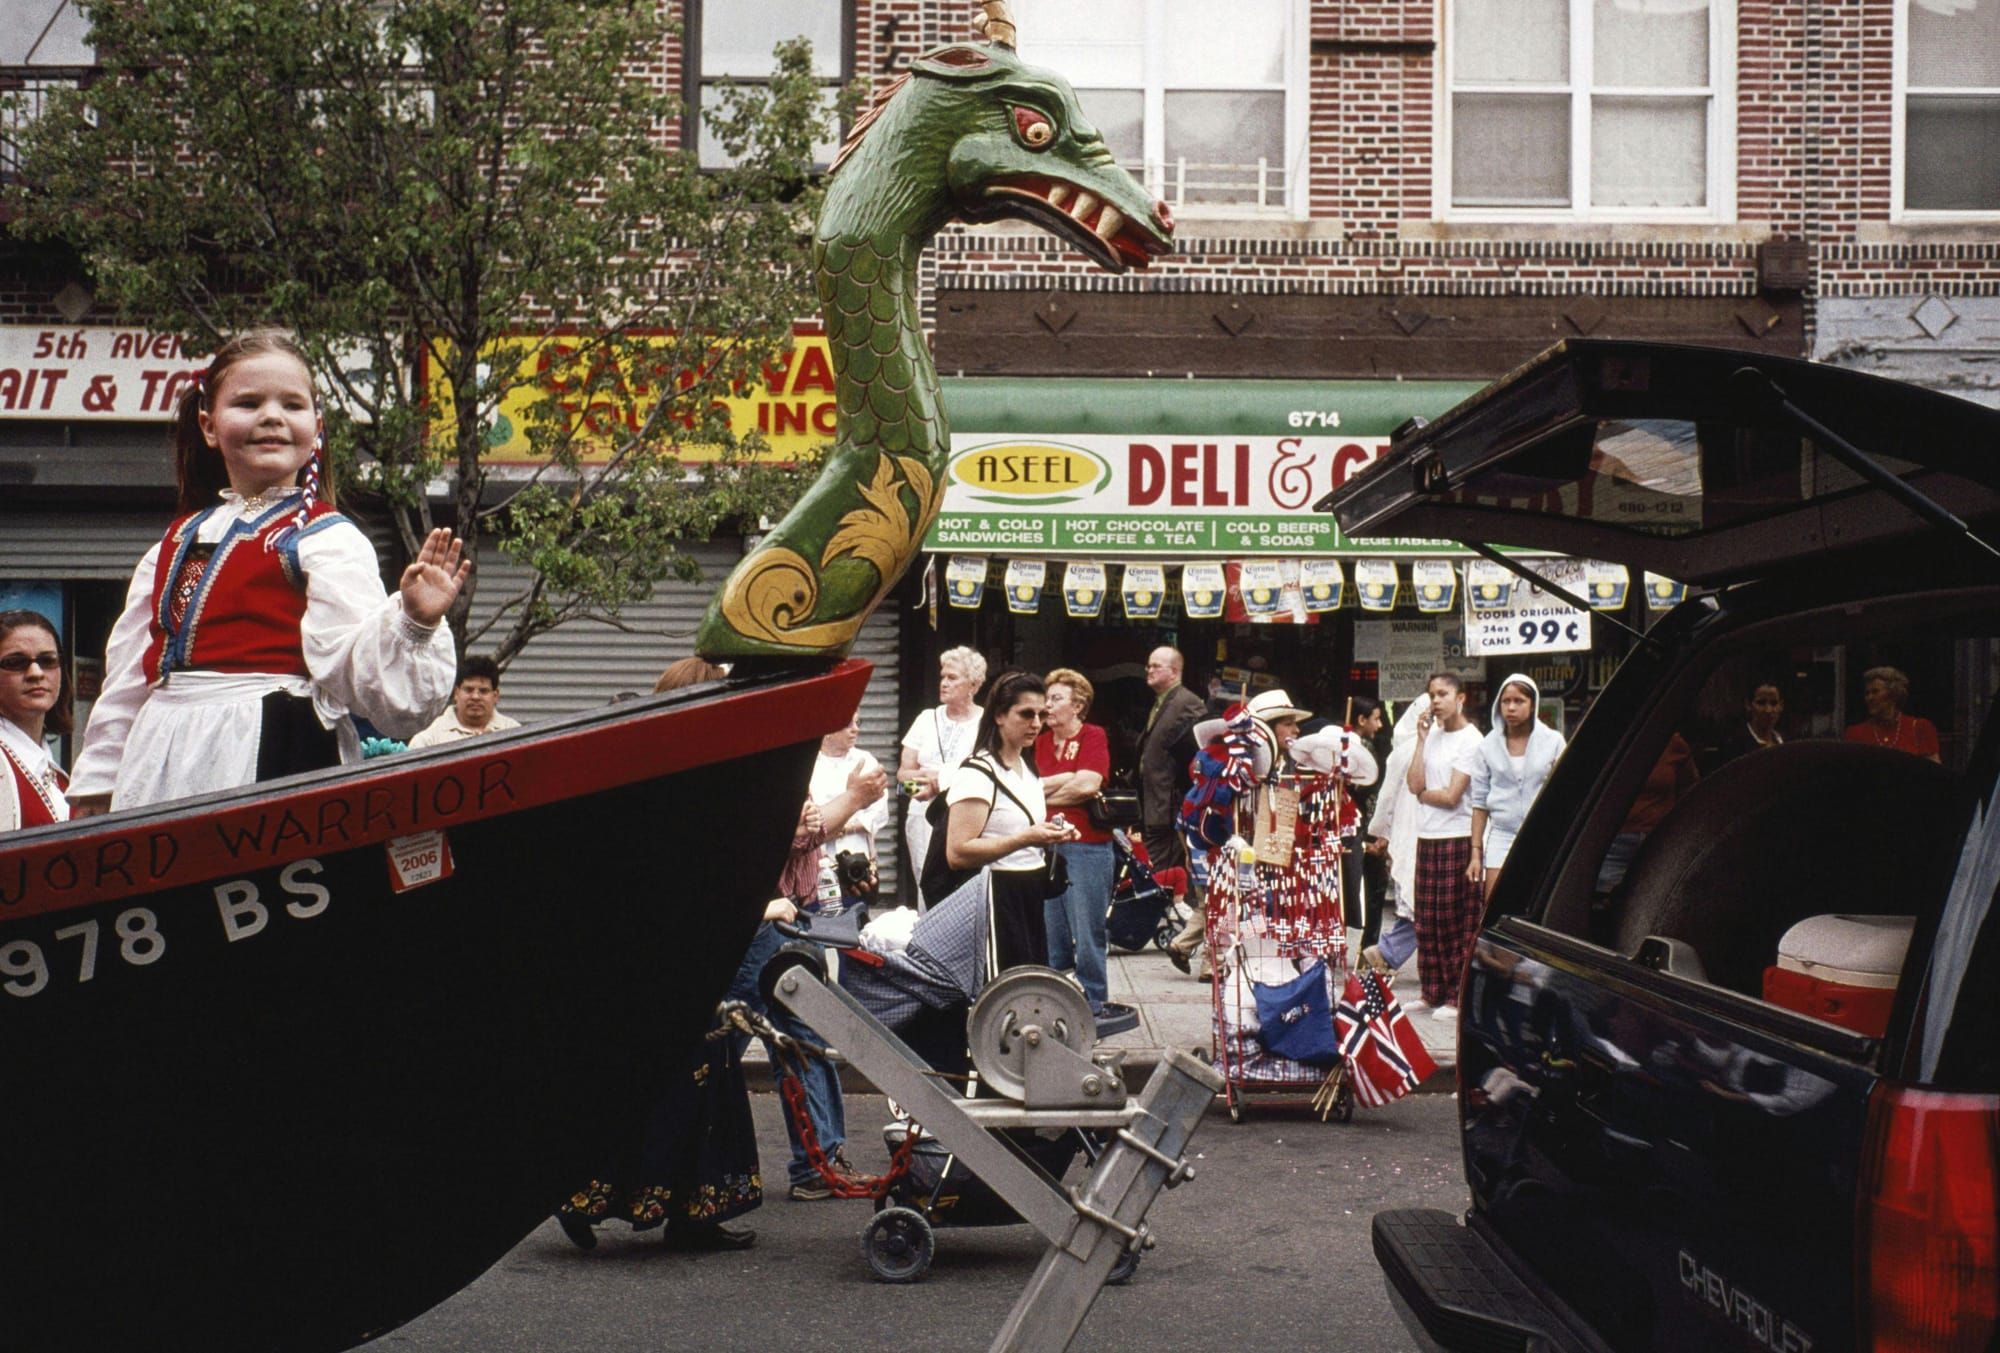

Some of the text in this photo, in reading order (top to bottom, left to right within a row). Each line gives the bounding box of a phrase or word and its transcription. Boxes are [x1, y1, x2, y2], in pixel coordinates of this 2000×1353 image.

[33, 330, 88, 359] 5th
[82, 374, 118, 412] &
[1288, 411, 1341, 428] 6714
[976, 456, 1080, 484] ASEEL
[1128, 443, 1250, 507] DELI
[1268, 438, 1317, 510] &
[938, 519, 1044, 531] HOT & COLD
[1066, 520, 1205, 532] HOT CHOCOLATE
[1226, 522, 1331, 534] COLD BEERS
[937, 531, 1044, 544] SANDWICHES
[1073, 533, 1197, 545] COFFEE & TEA
[1240, 535, 1315, 547] & SODAS
[1476, 606, 1578, 621] COORS ORIGINAL
[1391, 622, 1438, 633] WARNING
[1518, 620, 1579, 645] 99¢
[1482, 637, 1511, 646] CANS
[216, 759, 515, 859] WARRIOR
[401, 850, 438, 872] 2006
[0, 858, 331, 998] 978 BS
